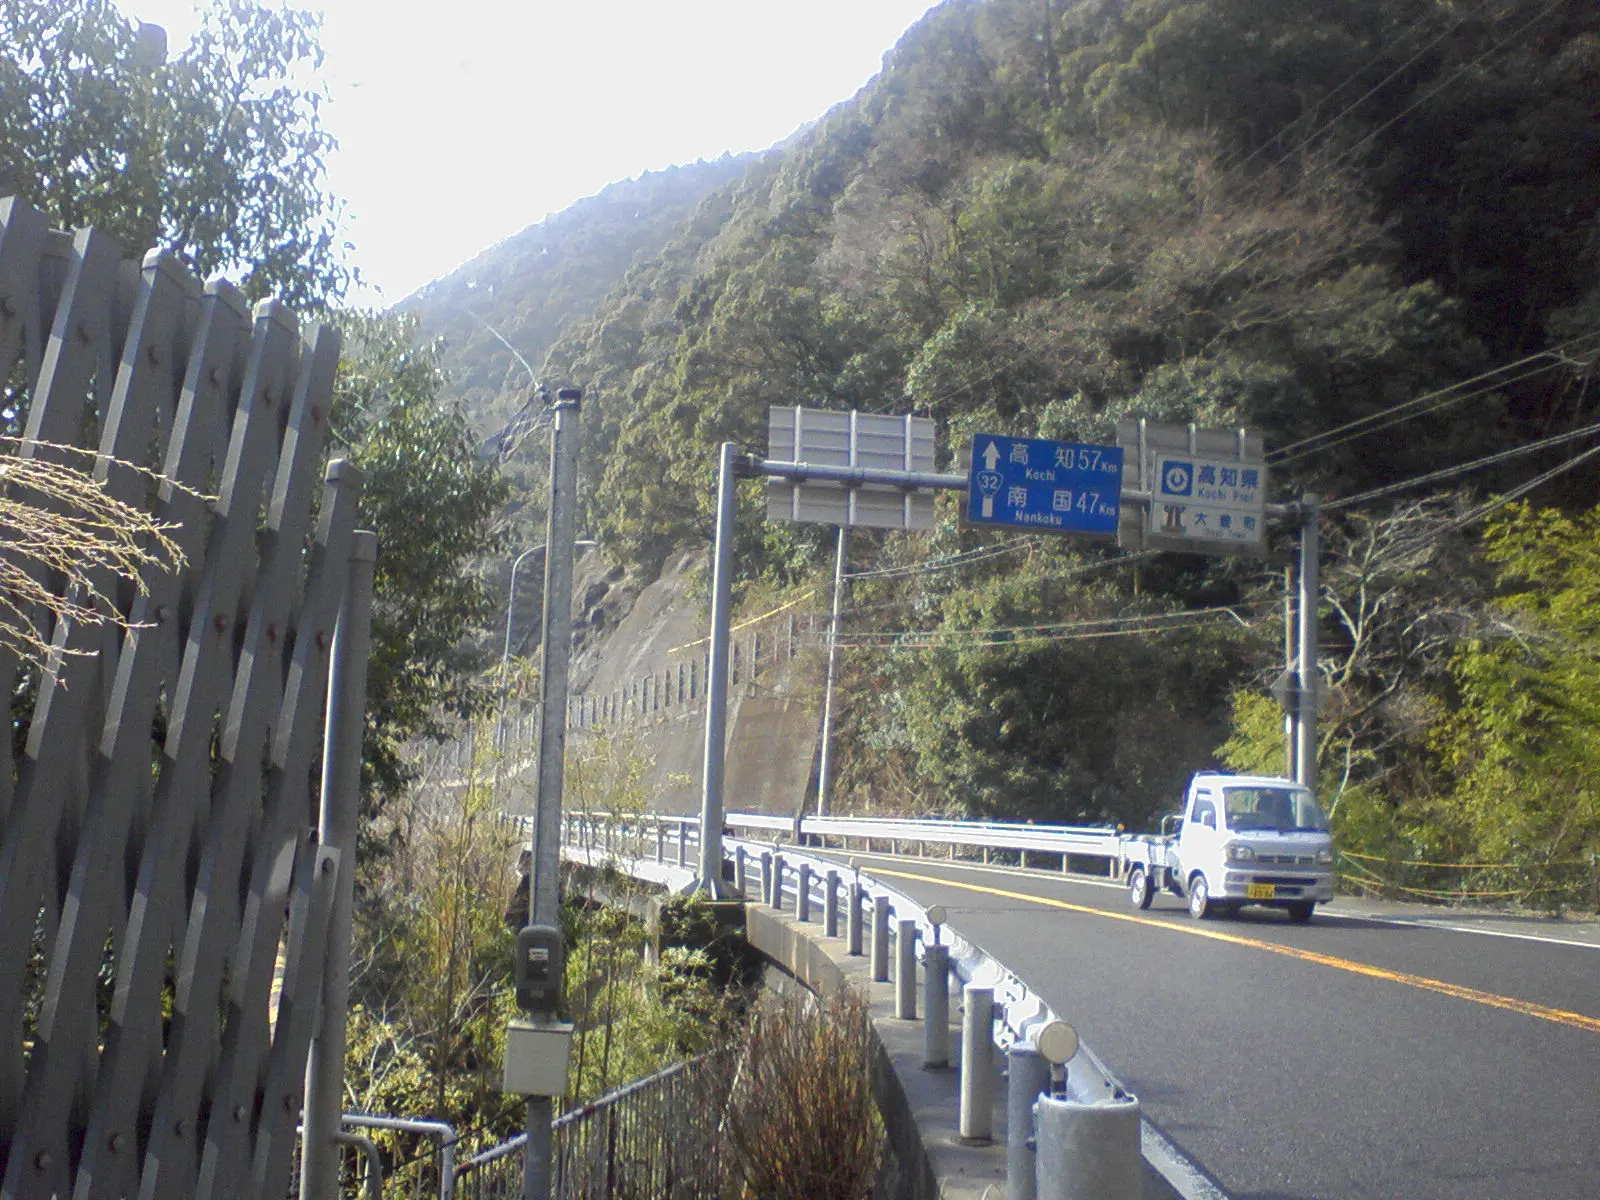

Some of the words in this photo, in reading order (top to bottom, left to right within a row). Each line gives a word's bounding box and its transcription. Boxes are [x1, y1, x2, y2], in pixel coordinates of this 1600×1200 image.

[1025, 468, 1056, 481] Kochi
[1198, 464, 1259, 488] 高知県
[981, 475, 998, 490] 32
[1015, 510, 1062, 526] Nankoku
